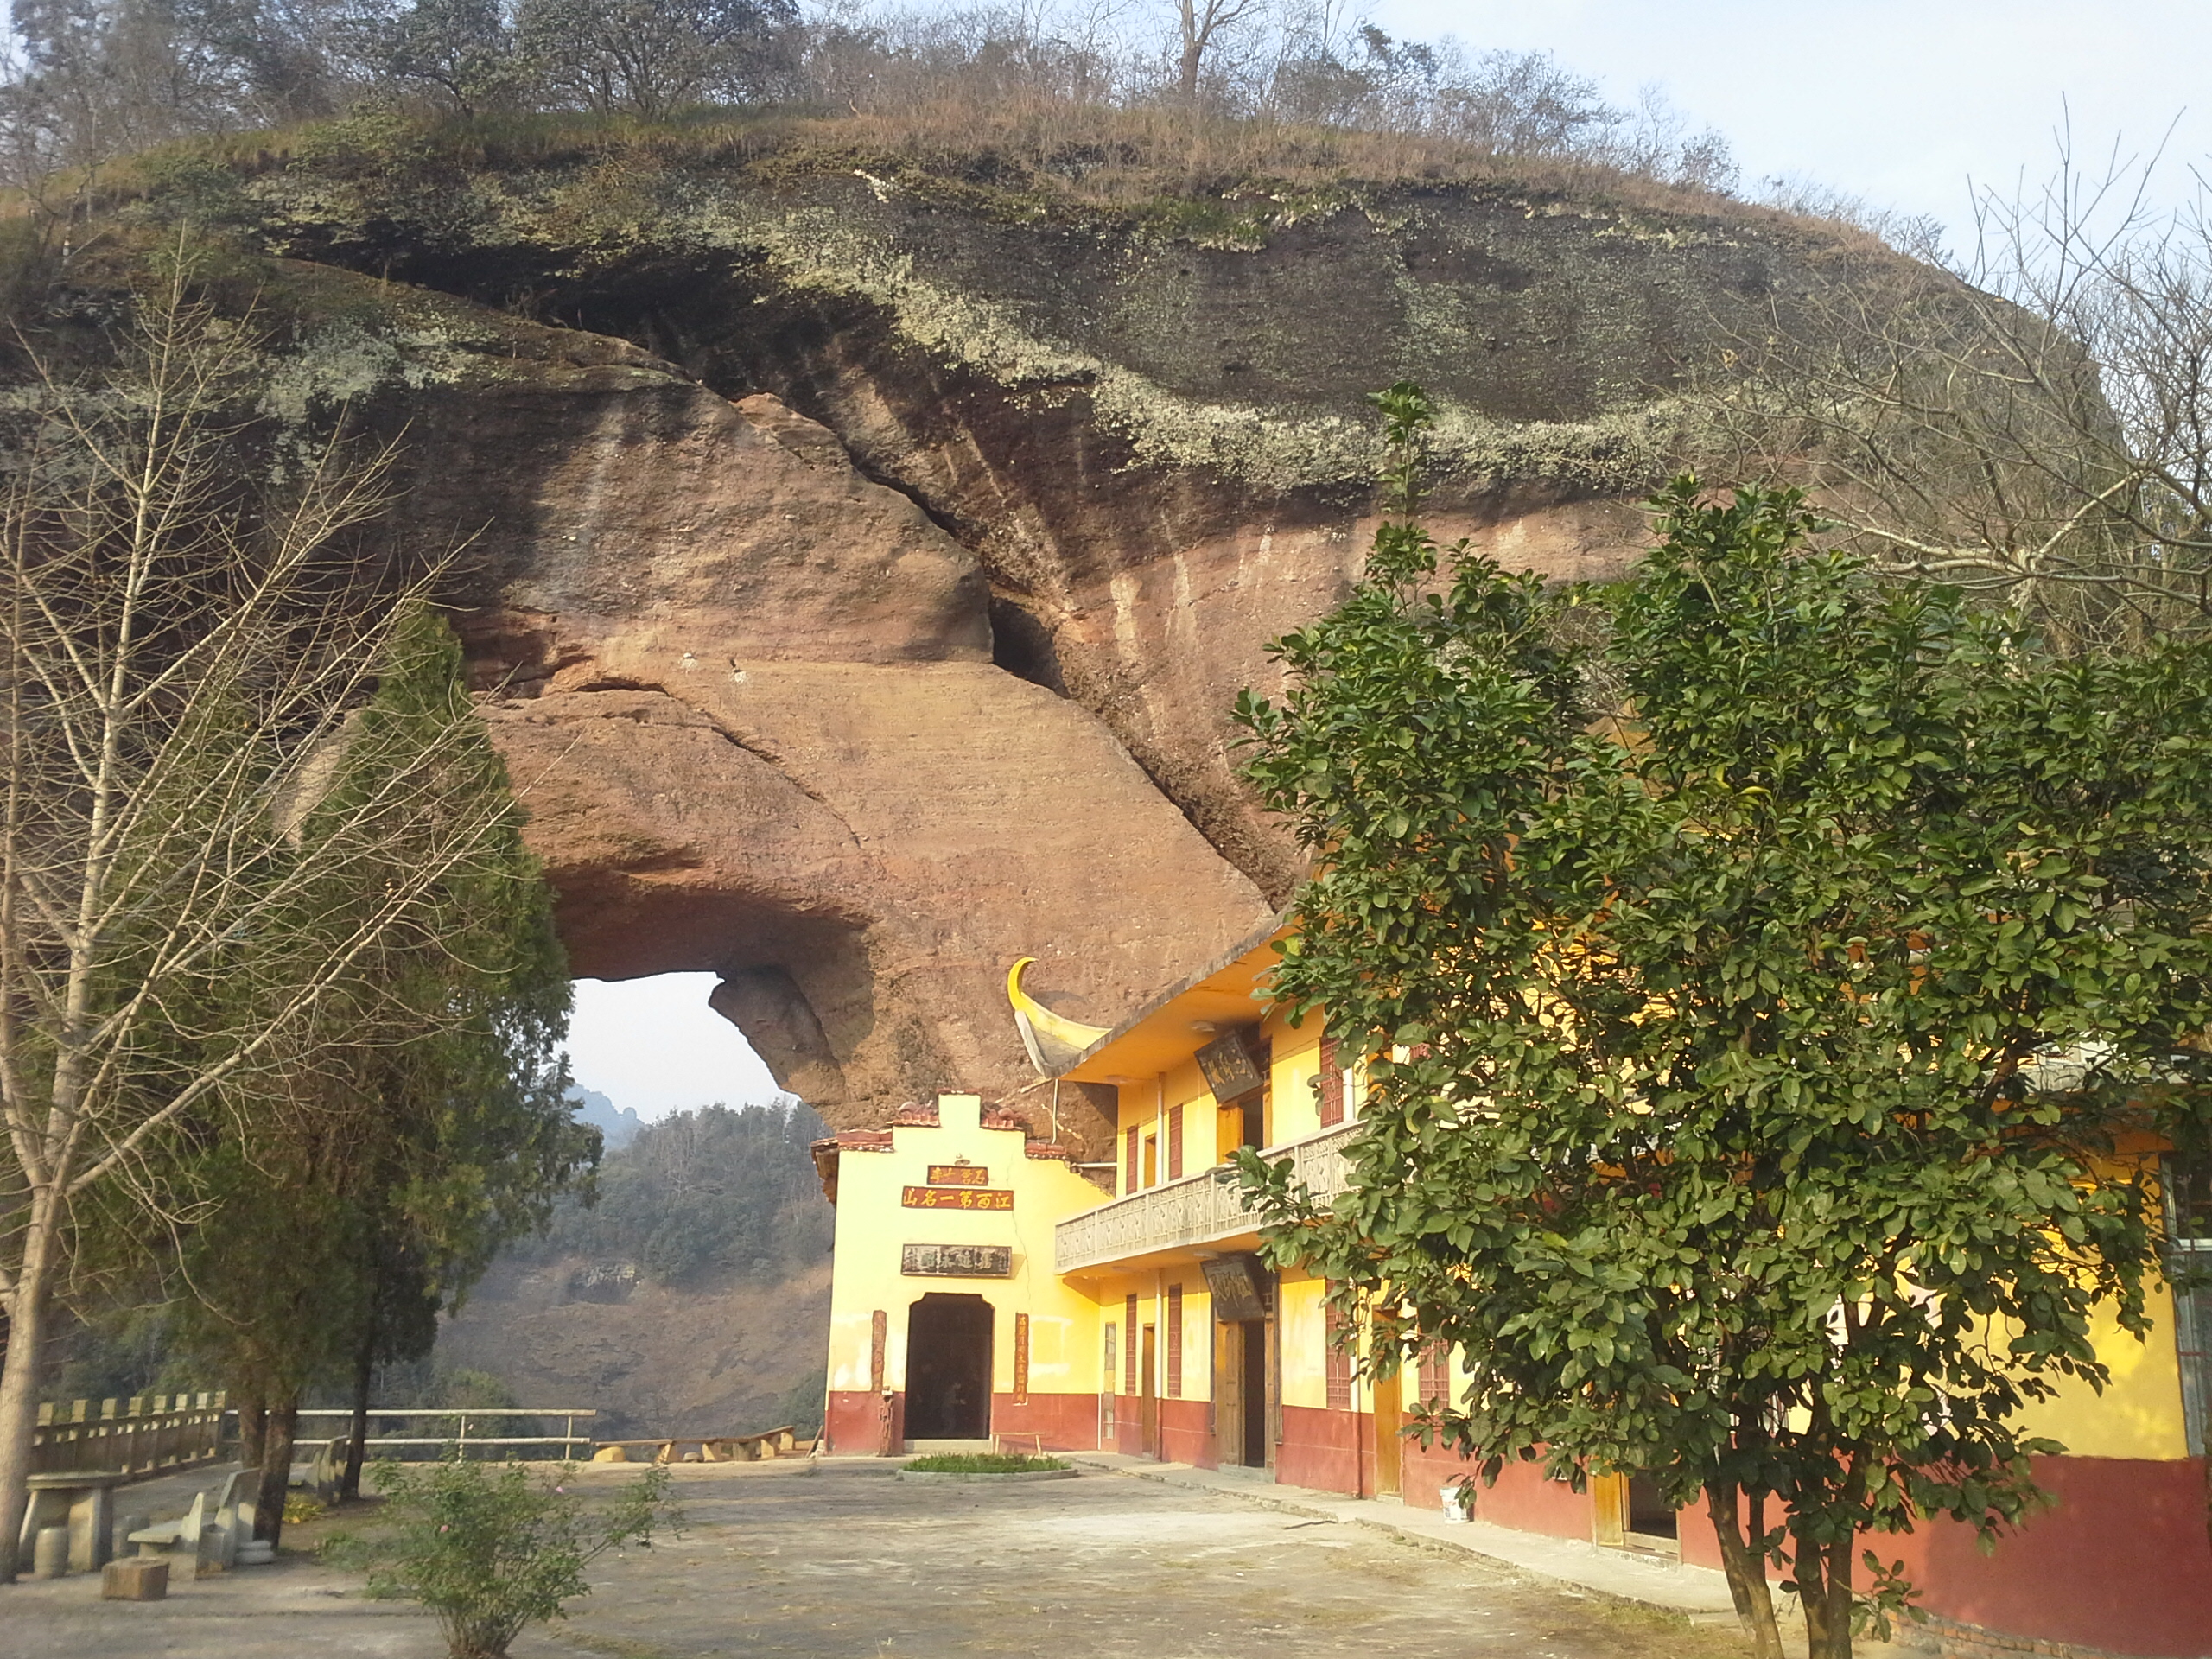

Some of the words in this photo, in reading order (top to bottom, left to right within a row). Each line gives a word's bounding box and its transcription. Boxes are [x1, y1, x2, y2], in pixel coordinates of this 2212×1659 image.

[903, 1188, 1011, 1209] 江西第一名山
